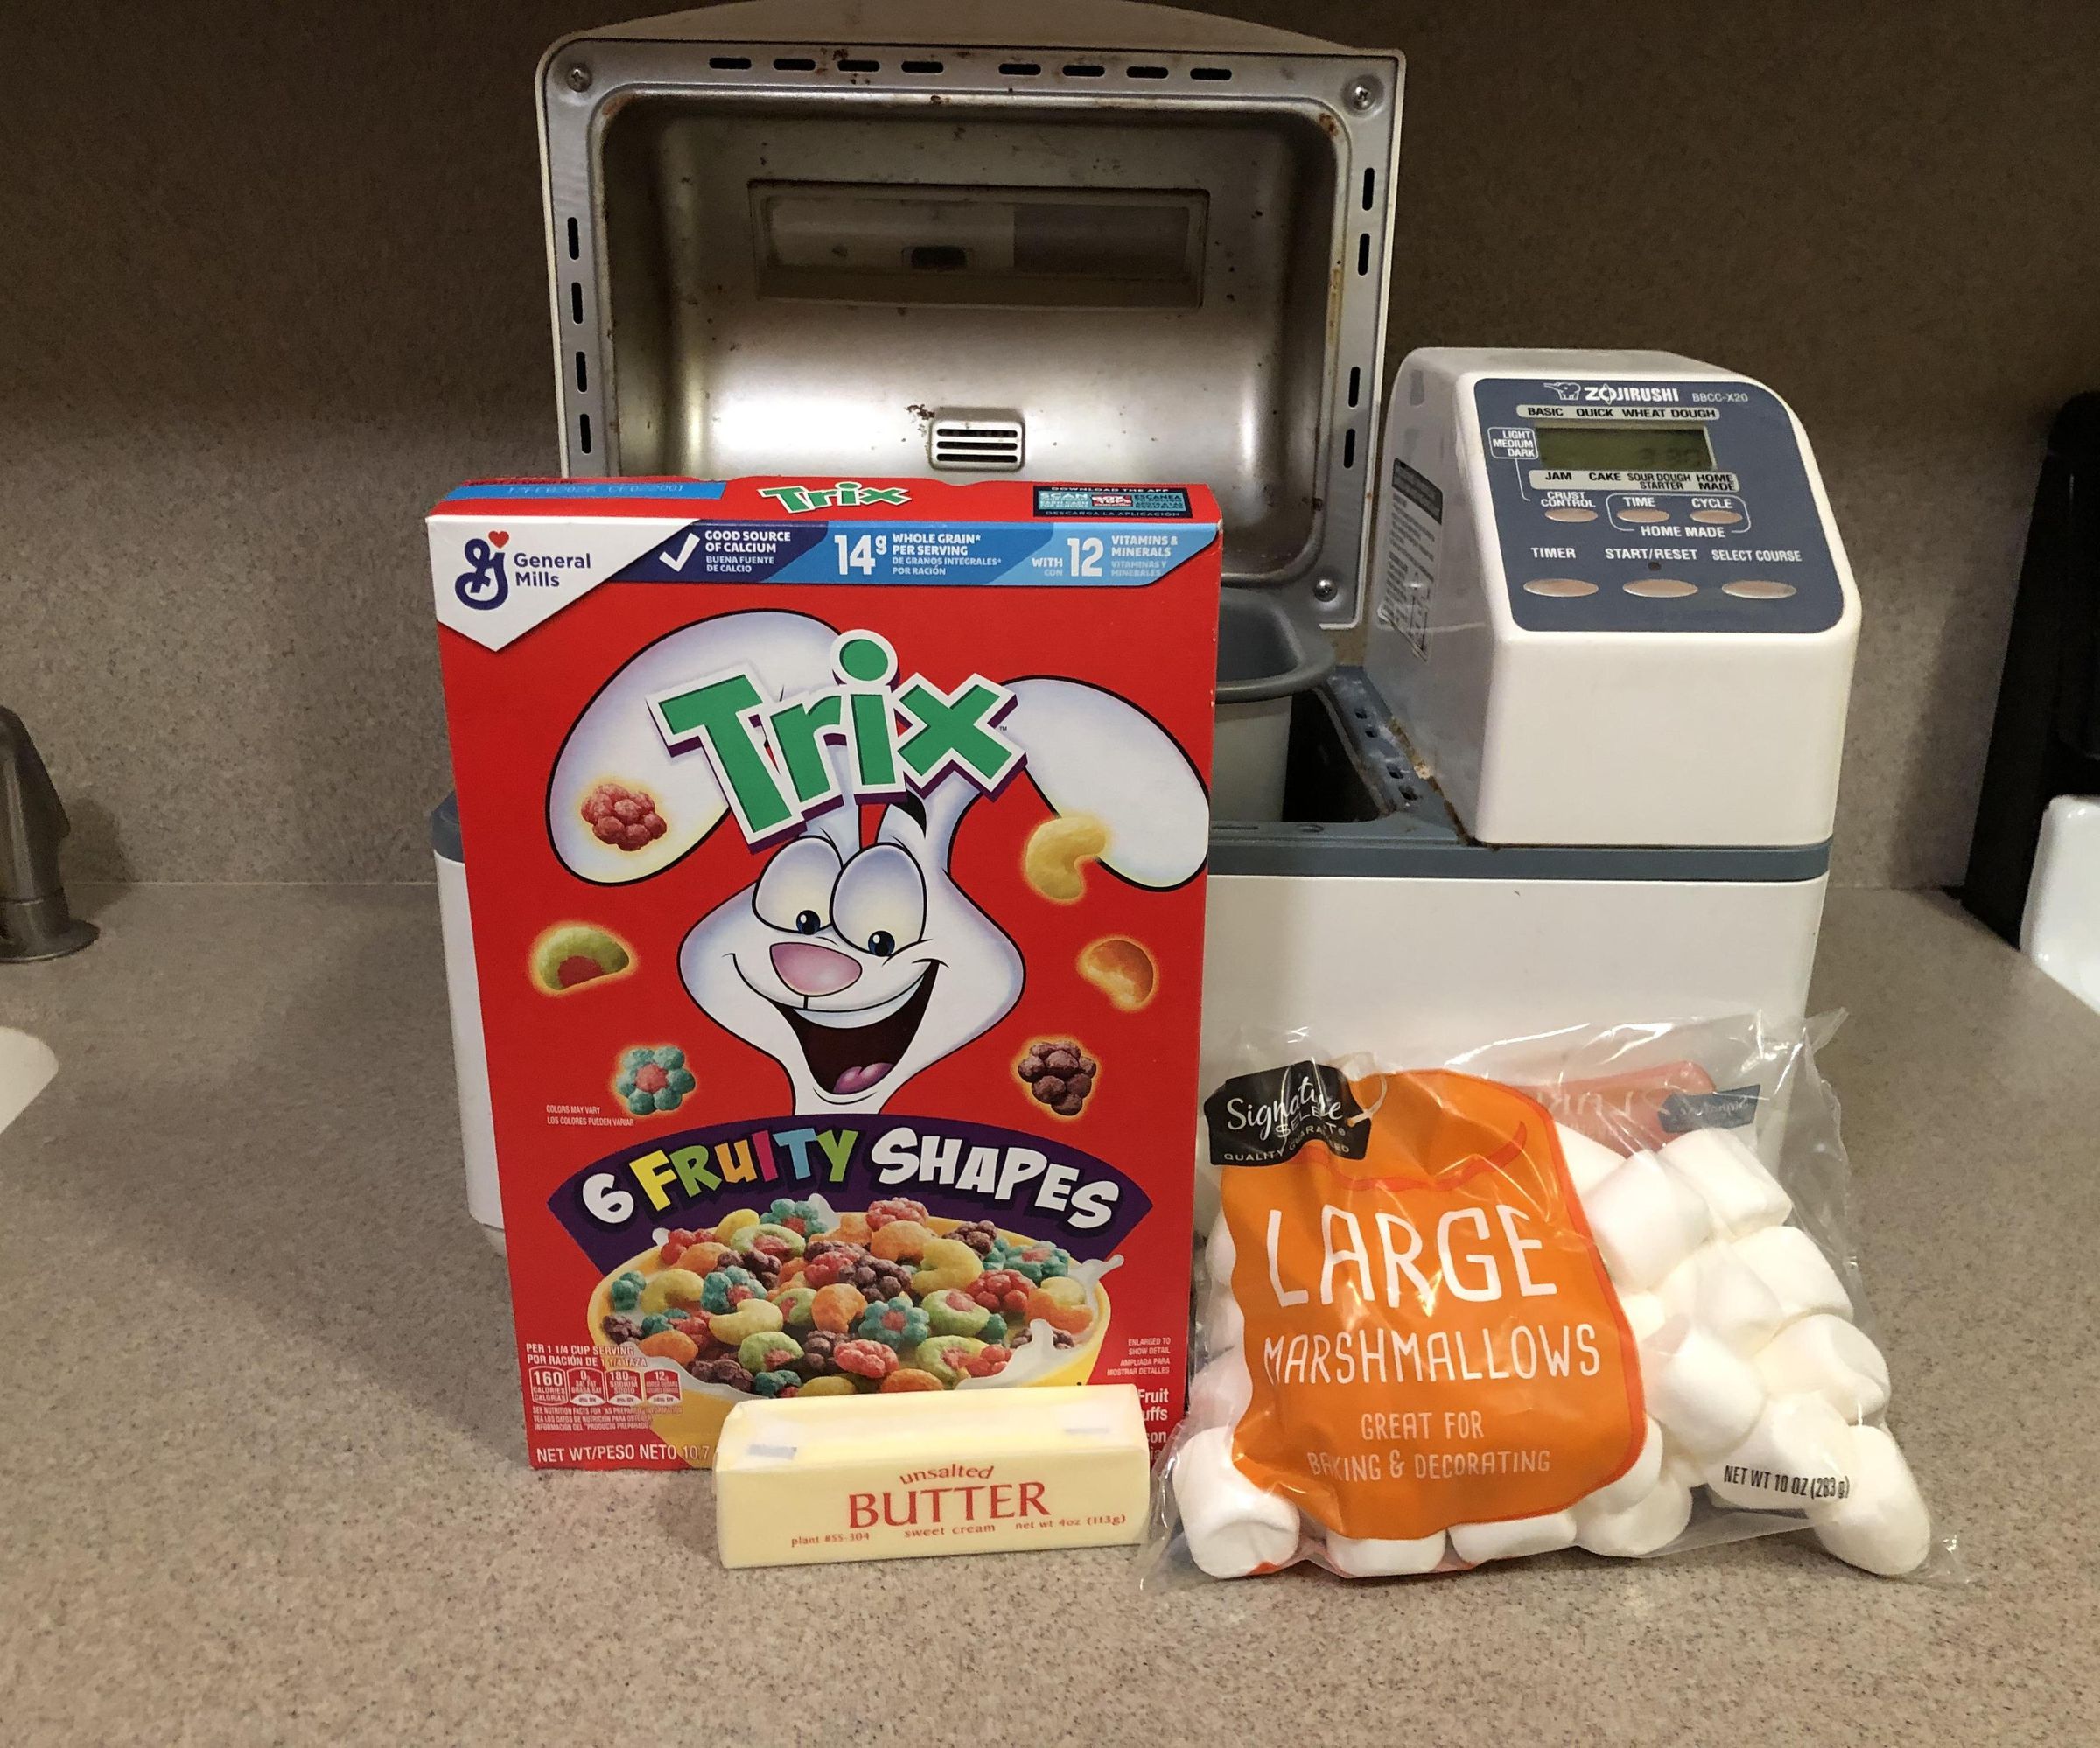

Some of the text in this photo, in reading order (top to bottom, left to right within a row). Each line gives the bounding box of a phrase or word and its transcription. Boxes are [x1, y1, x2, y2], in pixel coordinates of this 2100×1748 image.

[1585, 385, 1678, 404] ZOJIRUSHI
[1692, 393, 1748, 403] BBCC-X20
[1528, 407, 1716, 419] BASIC QUICK WHEAT DOUGH
[1502, 430, 1530, 439] LIGHT
[1493, 439, 1533, 448] MEDIUM
[1508, 448, 1535, 458] DARK
[1545, 472, 1572, 481] JAM
[1589, 472, 1621, 481] CAKE
[1628, 472, 1691, 482] SOUR DOUGH
[1697, 473, 1733, 483] HOME
[1640, 481, 1684, 490] STARTER
[1699, 482, 1735, 491] MADE
[758, 481, 912, 514] Trix
[1547, 491, 1585, 500] CRUST
[1541, 499, 1596, 507] CONTROL
[1623, 497, 1655, 507] TIME
[1692, 498, 1732, 508] CYCLE
[704, 530, 791, 542] GOOD SOURCE
[1641, 526, 1726, 538] HOME MADE
[892, 533, 934, 544] WHOLE
[1111, 535, 1179, 546] VITAMINS &
[704, 542, 777, 554] OF CALCIUM
[892, 544, 969, 556] PER SERVING
[1111, 547, 1171, 557] MINERALS
[1531, 548, 1576, 559] TIMER
[1068, 537, 1103, 577] 12
[1605, 549, 1698, 560] START/RESET
[1712, 549, 1802, 562] SELECT COURSE
[514, 553, 592, 570] General
[706, 556, 774, 565] BUENA FUENTE
[892, 556, 903, 565] DE
[906, 556, 941, 566] GRANOS
[1032, 557, 1063, 569] WITH
[1110, 560, 1159, 569] VITAMINAS
[706, 564, 752, 573] DE CALCIO
[892, 565, 946, 576] POR RACIÓN
[1043, 568, 1063, 577] CON
[1110, 569, 1162, 577] MINERALES
[515, 571, 560, 588] Mills
[646, 629, 1027, 853] Trix
[546, 1105, 570, 1114] COLORS
[570, 1105, 584, 1114] MAY
[547, 1116, 559, 1125] LOS
[560, 1117, 587, 1126] COLORES
[612, 1118, 634, 1127] VARIAR
[1224, 1149, 1284, 1161] QUALITY
[582, 1127, 1120, 1229] 6 FRUITY SHAPES
[1266, 1204, 1558, 1309] LARGE
[1128, 1338, 1161, 1346] ENLARGED
[526, 1344, 634, 1356] PER 1 1/4 CUP SERVING
[1149, 1346, 1171, 1355] DETAIL
[1264, 1323, 1600, 1386] MARSHMALLOWS
[528, 1354, 547, 1365] POR
[550, 1354, 583, 1367] RACIÓN
[585, 1357, 598, 1367] DE
[623, 1358, 648, 1367] TAZA
[1120, 1357, 1170, 1367] AMPLIADA PARA
[1107, 1367, 1170, 1376] MOSTRAR DETALLES
[533, 1371, 564, 1386] 160
[1362, 1410, 1485, 1442] GREAT FOR
[537, 1448, 564, 1463] NET
[570, 1444, 635, 1461] WT/PESO
[640, 1444, 677, 1460] NETO
[1307, 1450, 1550, 1481] BAKING & DECORATING
[900, 1464, 995, 1485] unsalted
[1724, 1465, 1851, 1500] NET WT 10 OZ (283 g)
[849, 1481, 1051, 1529] BUTTER
[1015, 1514, 1126, 1530] net wt 4oz (113g)
[904, 1522, 996, 1539] sweet cream
[791, 1534, 820, 1547] plant
